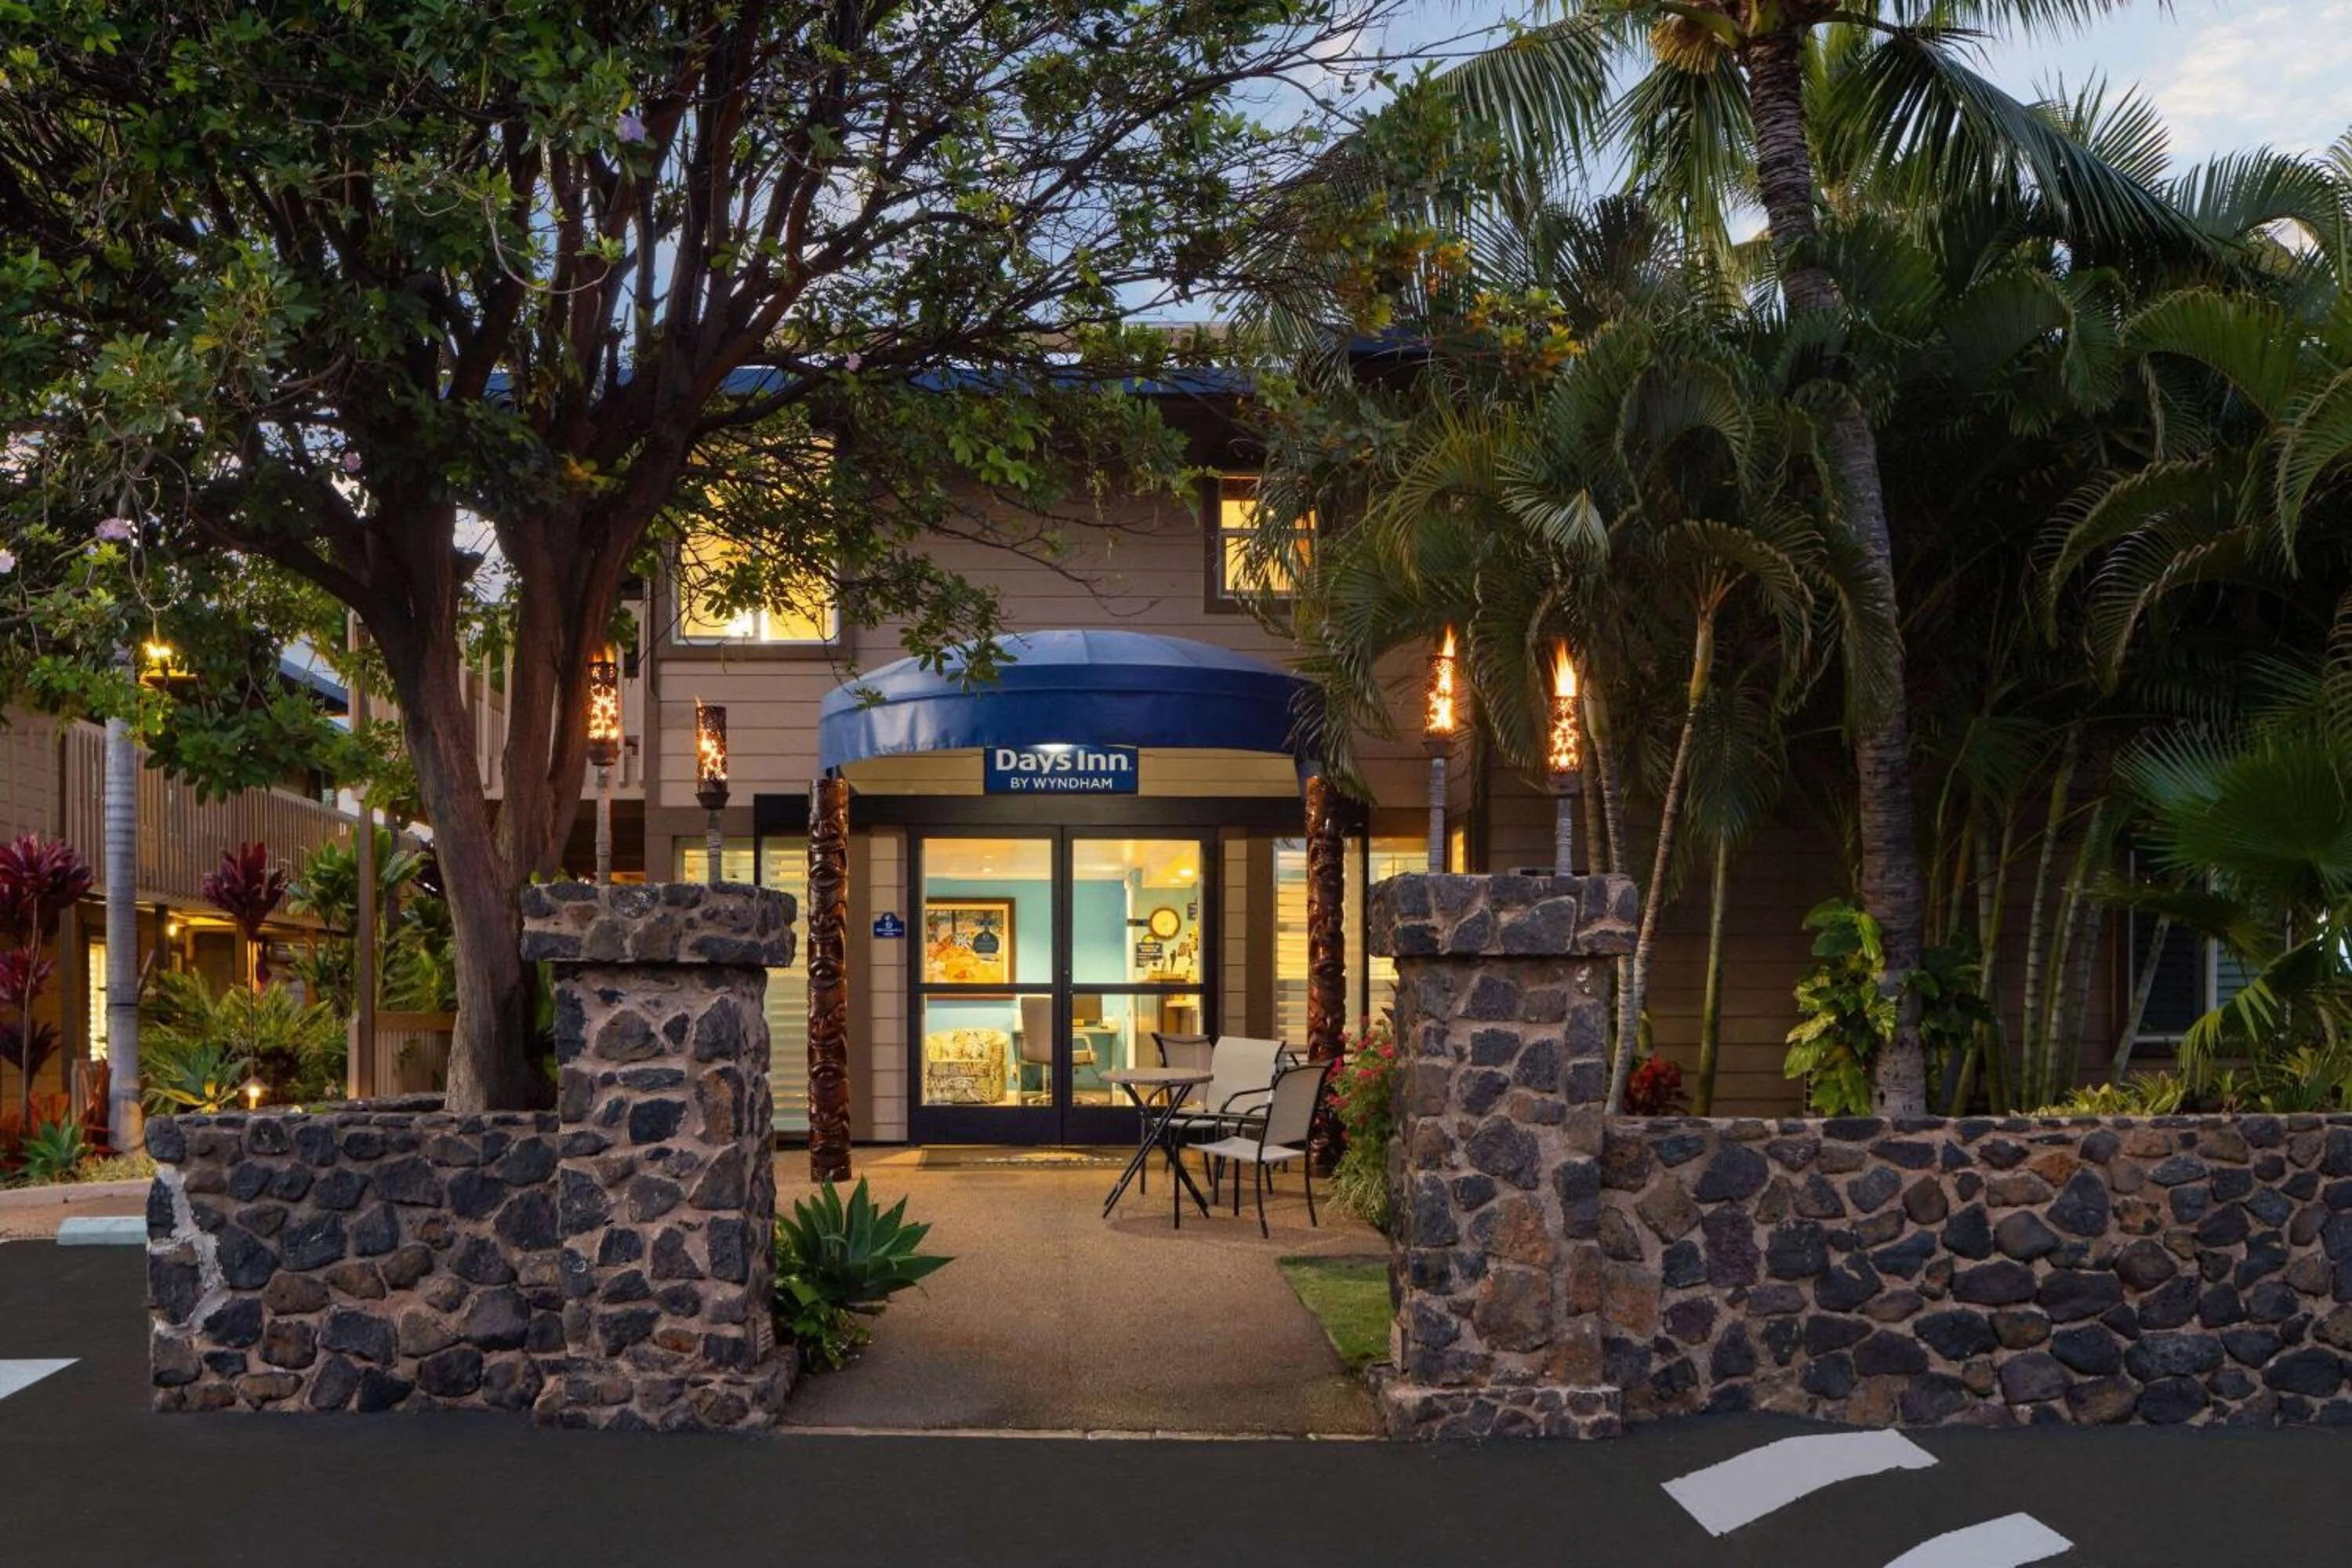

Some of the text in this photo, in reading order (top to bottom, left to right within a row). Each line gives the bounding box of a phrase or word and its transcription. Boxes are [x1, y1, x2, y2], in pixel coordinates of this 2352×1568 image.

[995, 749, 1128, 774] Days Inn
[1011, 777, 1113, 789] BY WYNDHAM
